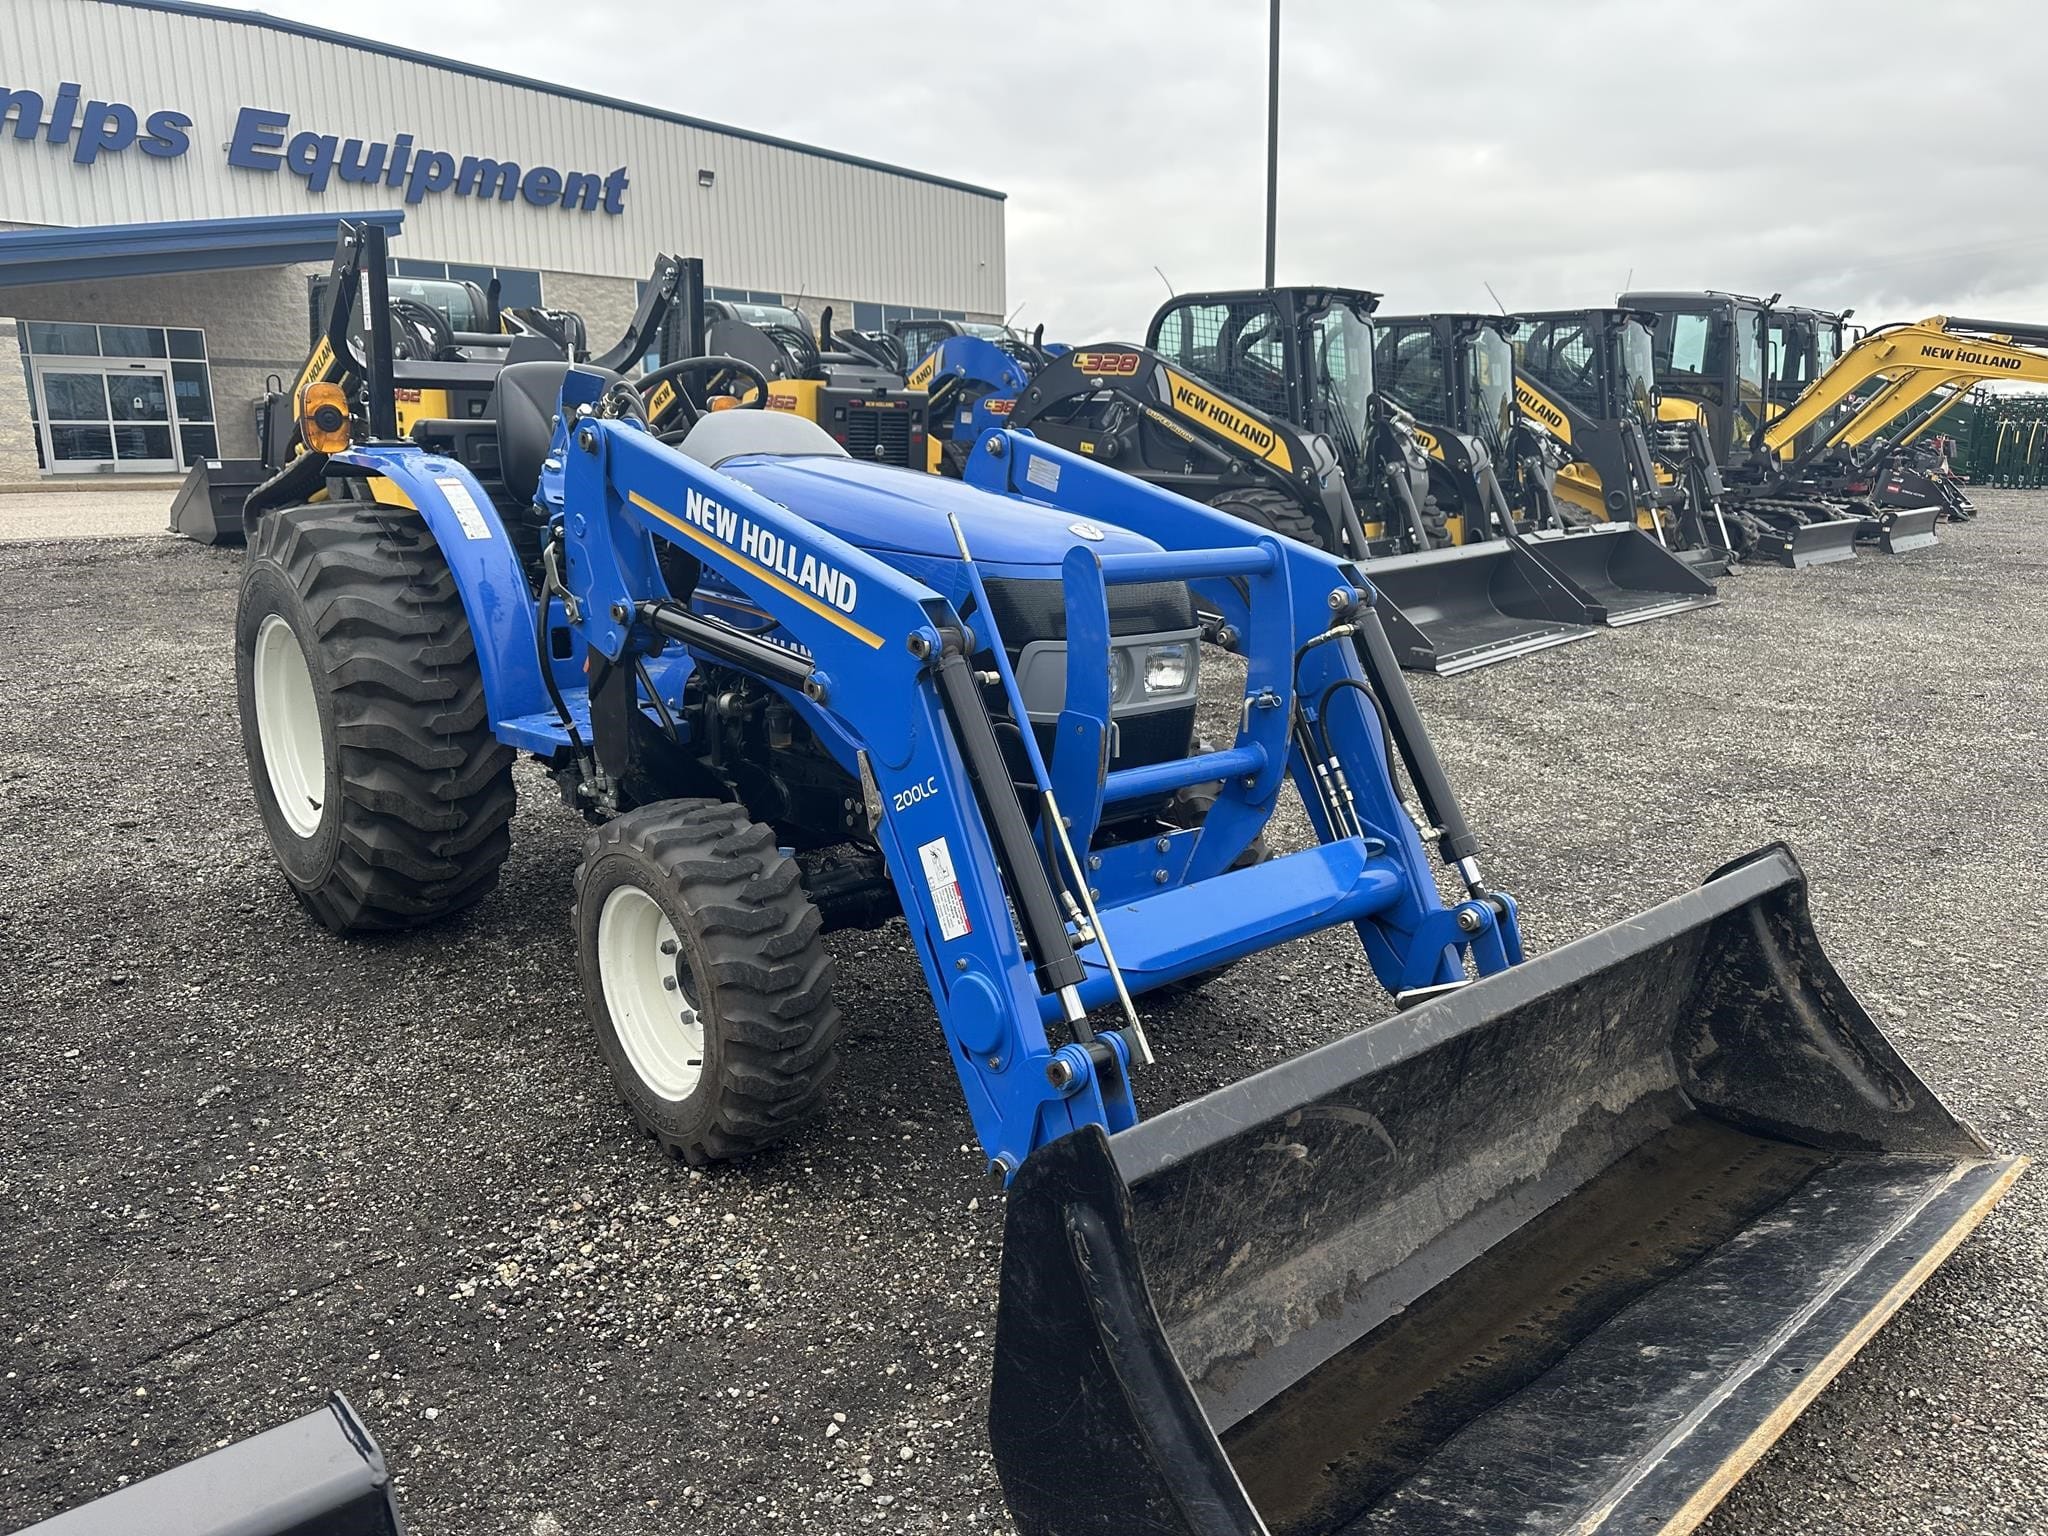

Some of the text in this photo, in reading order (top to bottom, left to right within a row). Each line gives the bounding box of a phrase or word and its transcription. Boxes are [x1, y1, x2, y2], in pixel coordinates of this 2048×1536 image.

[228, 106, 630, 215] Equipment
[308, 342, 333, 383] HOLLAN
[1073, 353, 1139, 375] L328
[1921, 345, 2021, 370] NEW HOLLAND
[653, 386, 671, 408] NEW
[1176, 386, 1271, 449] NEW HOLLAND
[685, 487, 858, 614] NEW HOLLAND
[893, 776, 938, 812] 200LC
